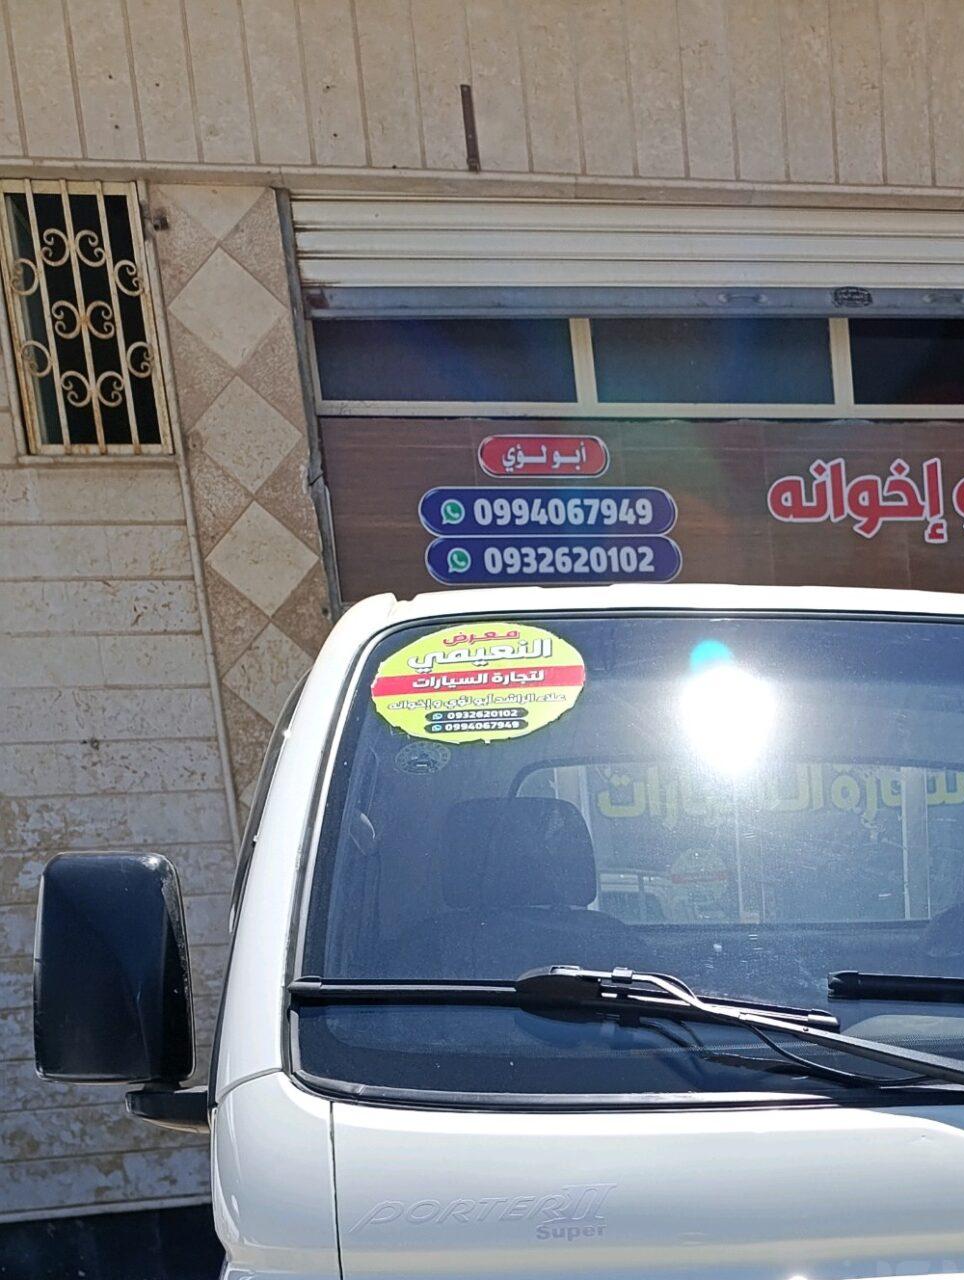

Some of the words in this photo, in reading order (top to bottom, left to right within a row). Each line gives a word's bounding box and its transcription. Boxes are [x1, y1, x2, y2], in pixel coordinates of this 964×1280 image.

[502, 443, 547, 472] لؤي
[551, 441, 586, 471] أبو
[473, 498, 653, 526] 0994067949
[768, 456, 949, 544] إخوانه
[484, 546, 655, 574] 0932620102
[442, 630, 520, 647] معرض
[407, 638, 553, 674] النعيمي
[412, 673, 488, 690] السيارات
[491, 669, 545, 687] لتجارة
[445, 721, 519, 732] 0994067949
[447, 709, 518, 720] 0932620102
[349, 1193, 573, 1233] PORTER
[535, 1224, 607, 1242] Super
